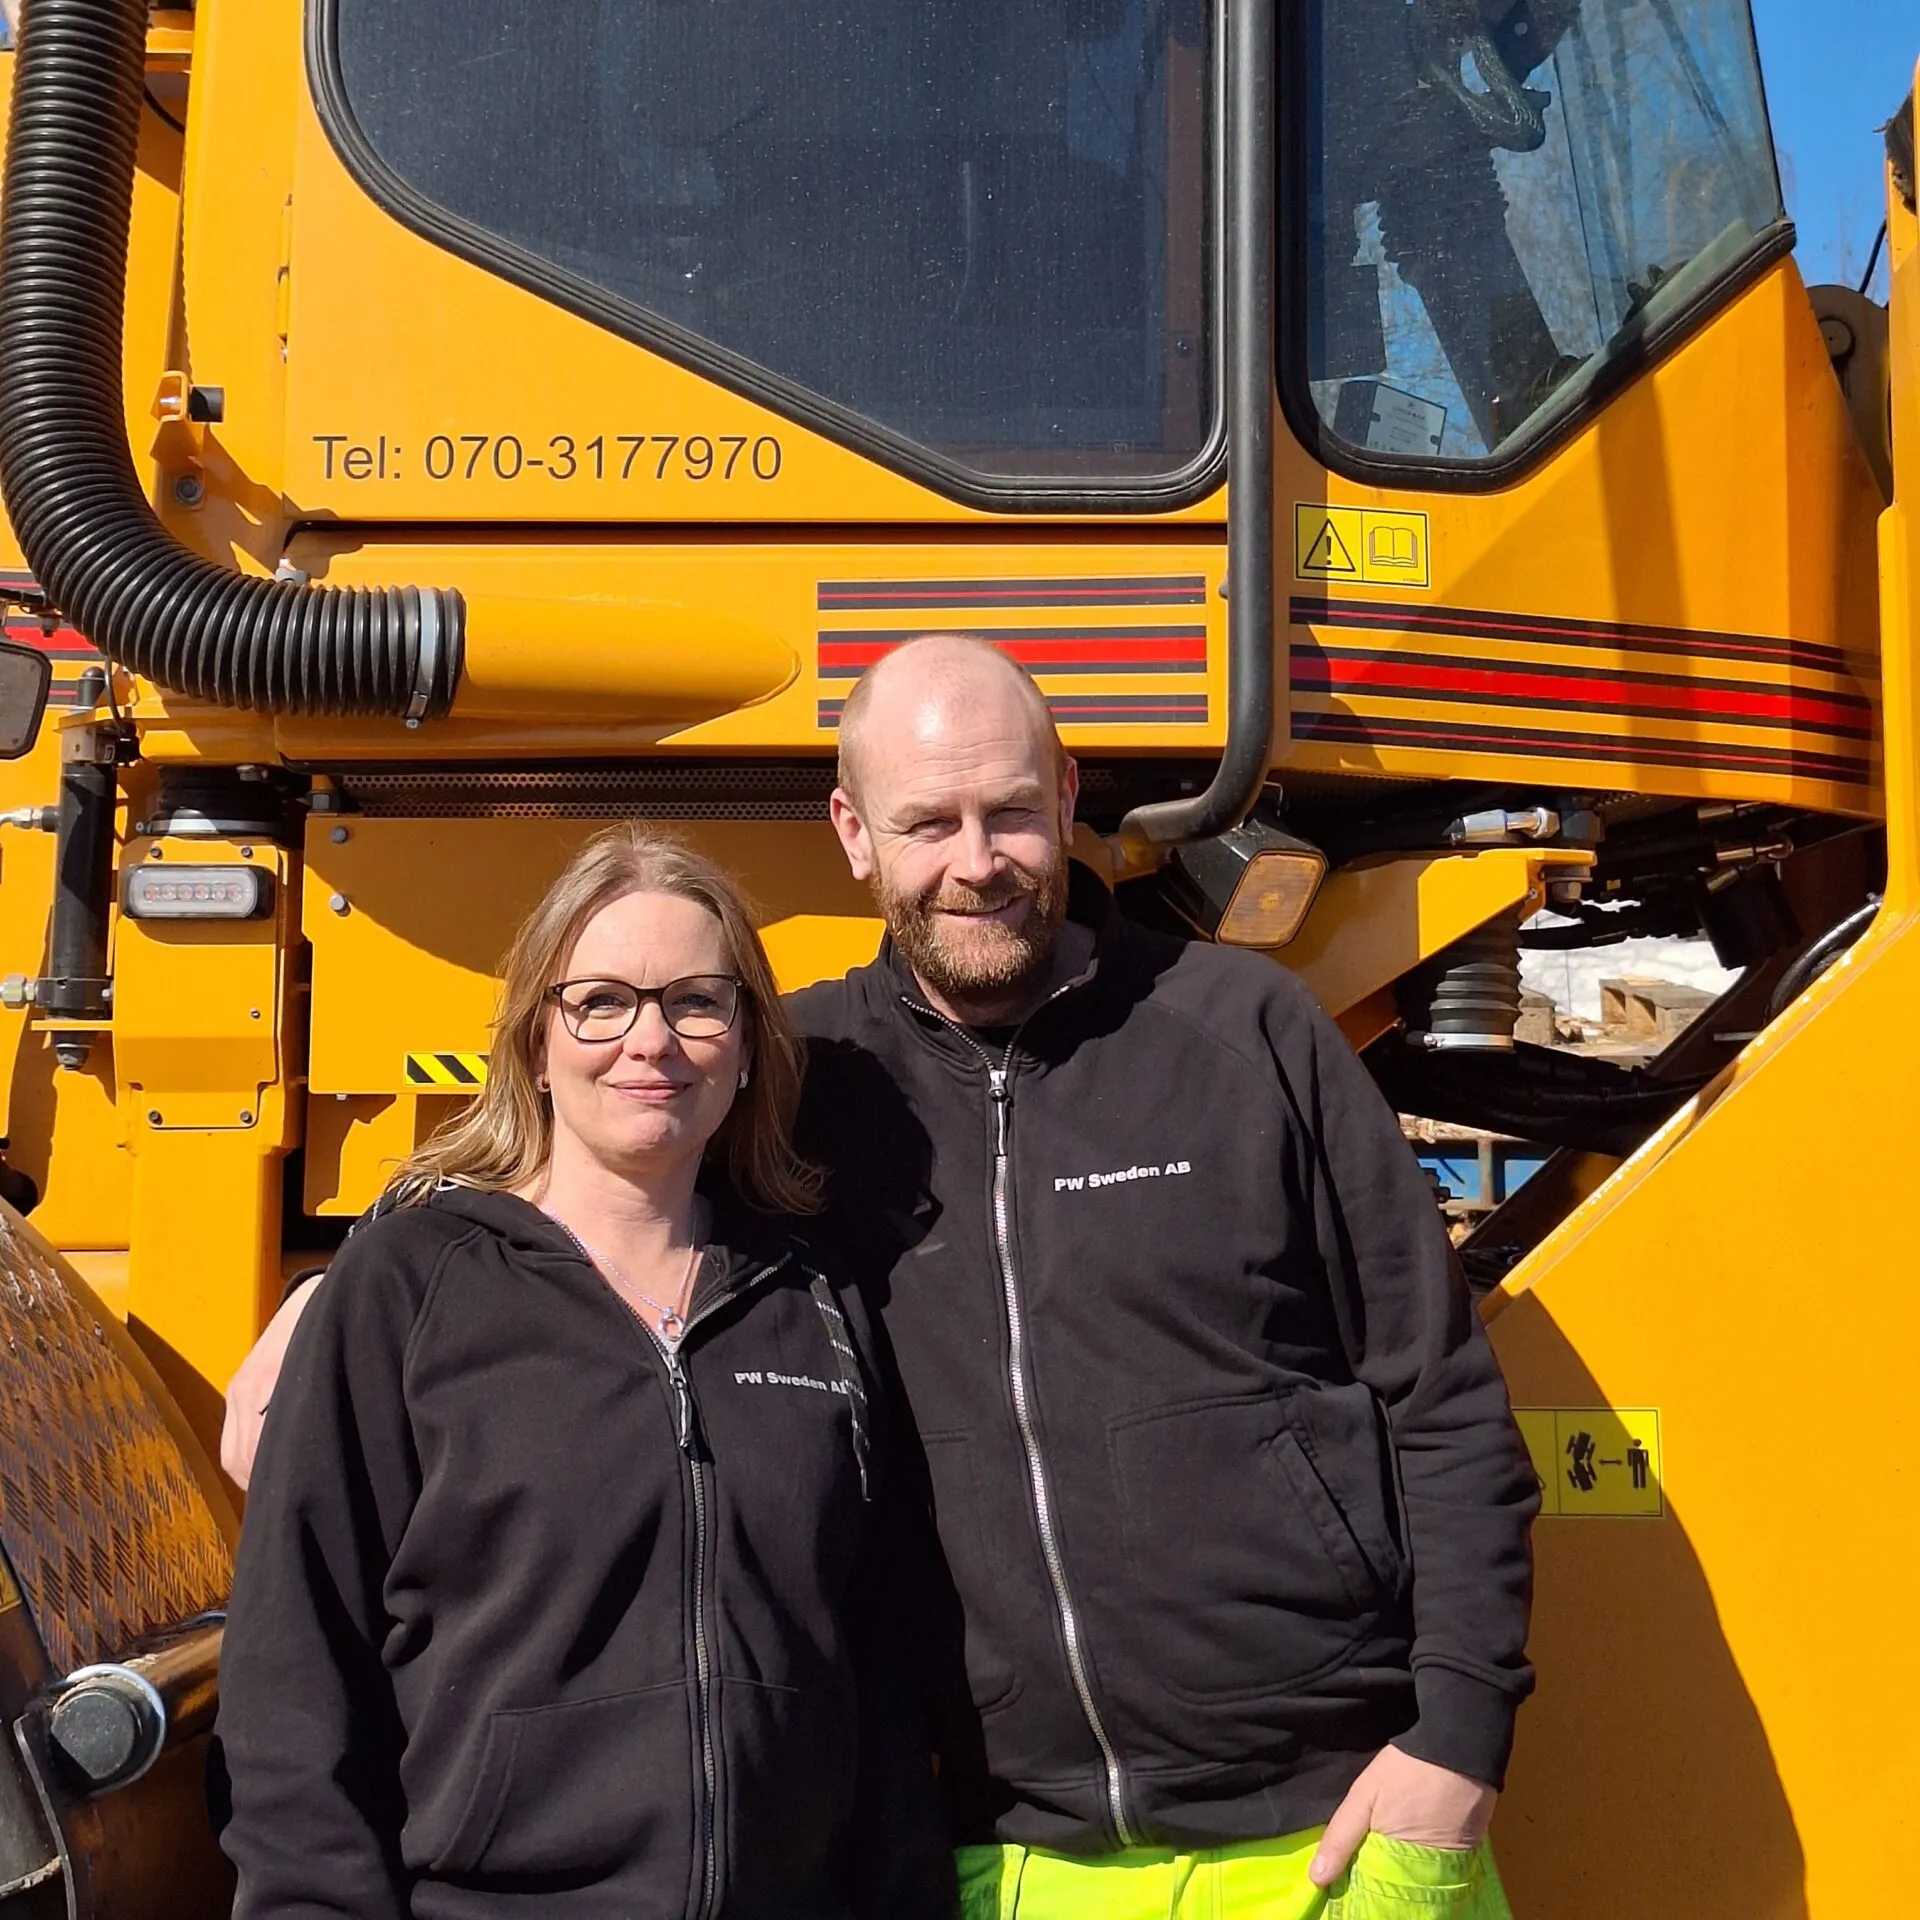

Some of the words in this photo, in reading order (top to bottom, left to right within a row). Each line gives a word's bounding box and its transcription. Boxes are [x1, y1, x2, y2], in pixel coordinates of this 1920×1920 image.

[313, 435, 402, 480] Tel:
[424, 435, 783, 481] 070-3177970
[1054, 1177, 1084, 1191] PW
[1088, 1166, 1160, 1188] Sweden
[1164, 1161, 1191, 1175] AB
[734, 1372, 762, 1384] PW
[766, 1372, 828, 1391] Sweden
